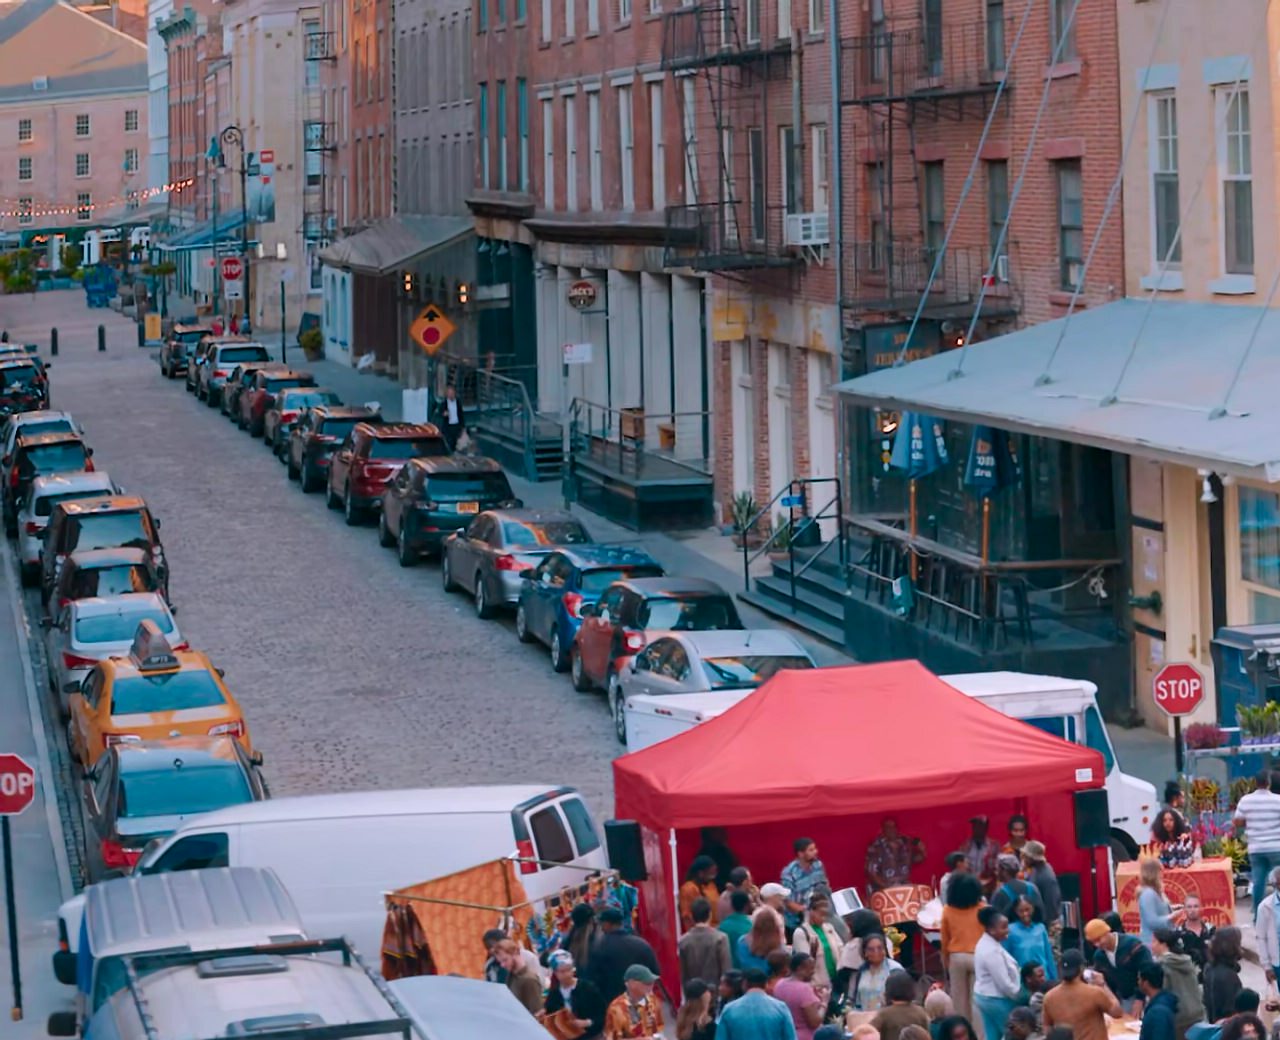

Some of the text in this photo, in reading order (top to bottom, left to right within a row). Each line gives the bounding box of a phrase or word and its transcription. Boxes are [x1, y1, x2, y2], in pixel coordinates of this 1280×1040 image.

[222, 263, 242, 275] STOP
[1156, 677, 1201, 701] STOP
[0, 772, 33, 796] OP
